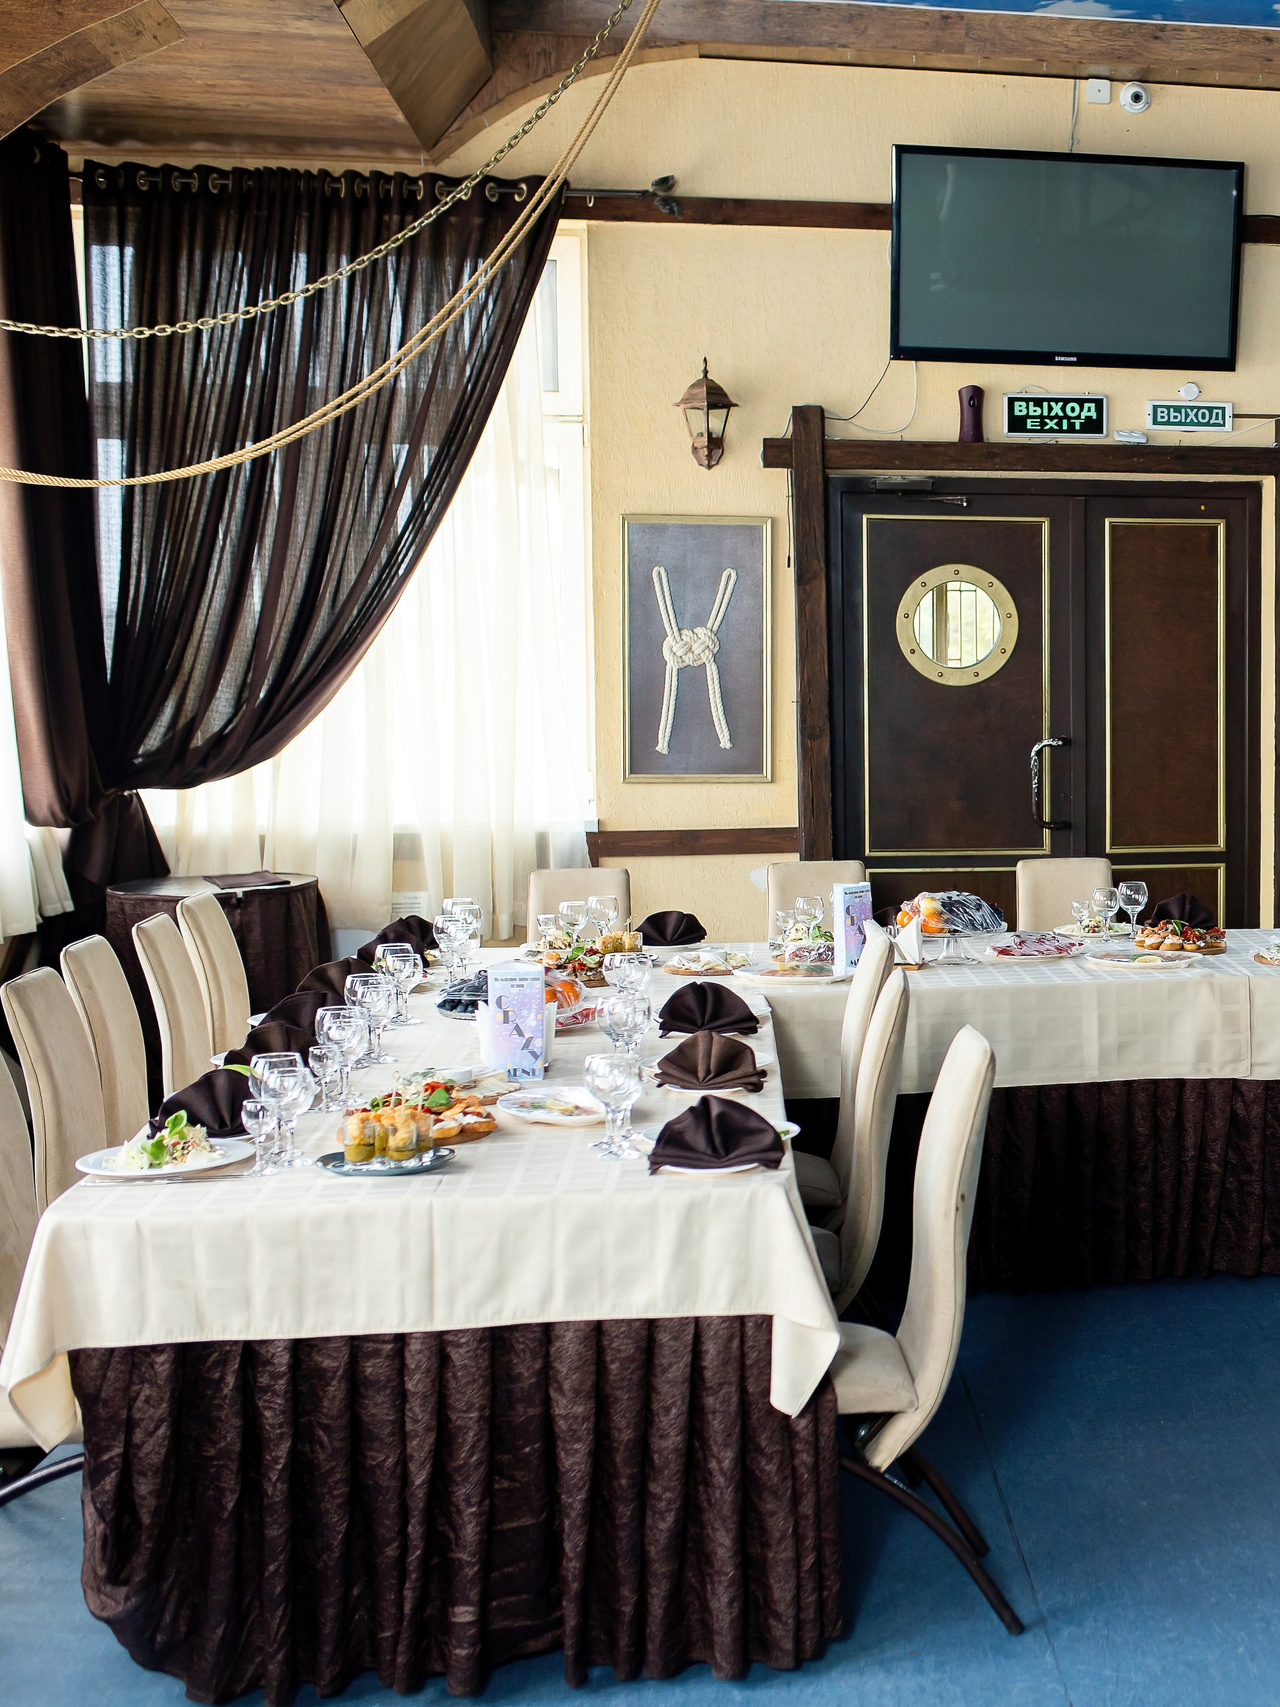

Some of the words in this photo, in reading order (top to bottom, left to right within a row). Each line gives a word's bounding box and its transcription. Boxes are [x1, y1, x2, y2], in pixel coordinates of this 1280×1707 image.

[1013, 401, 1097, 419] ВЫХОД
[1156, 407, 1224, 425] ВЫХОД
[1026, 419, 1085, 430] EXIT
